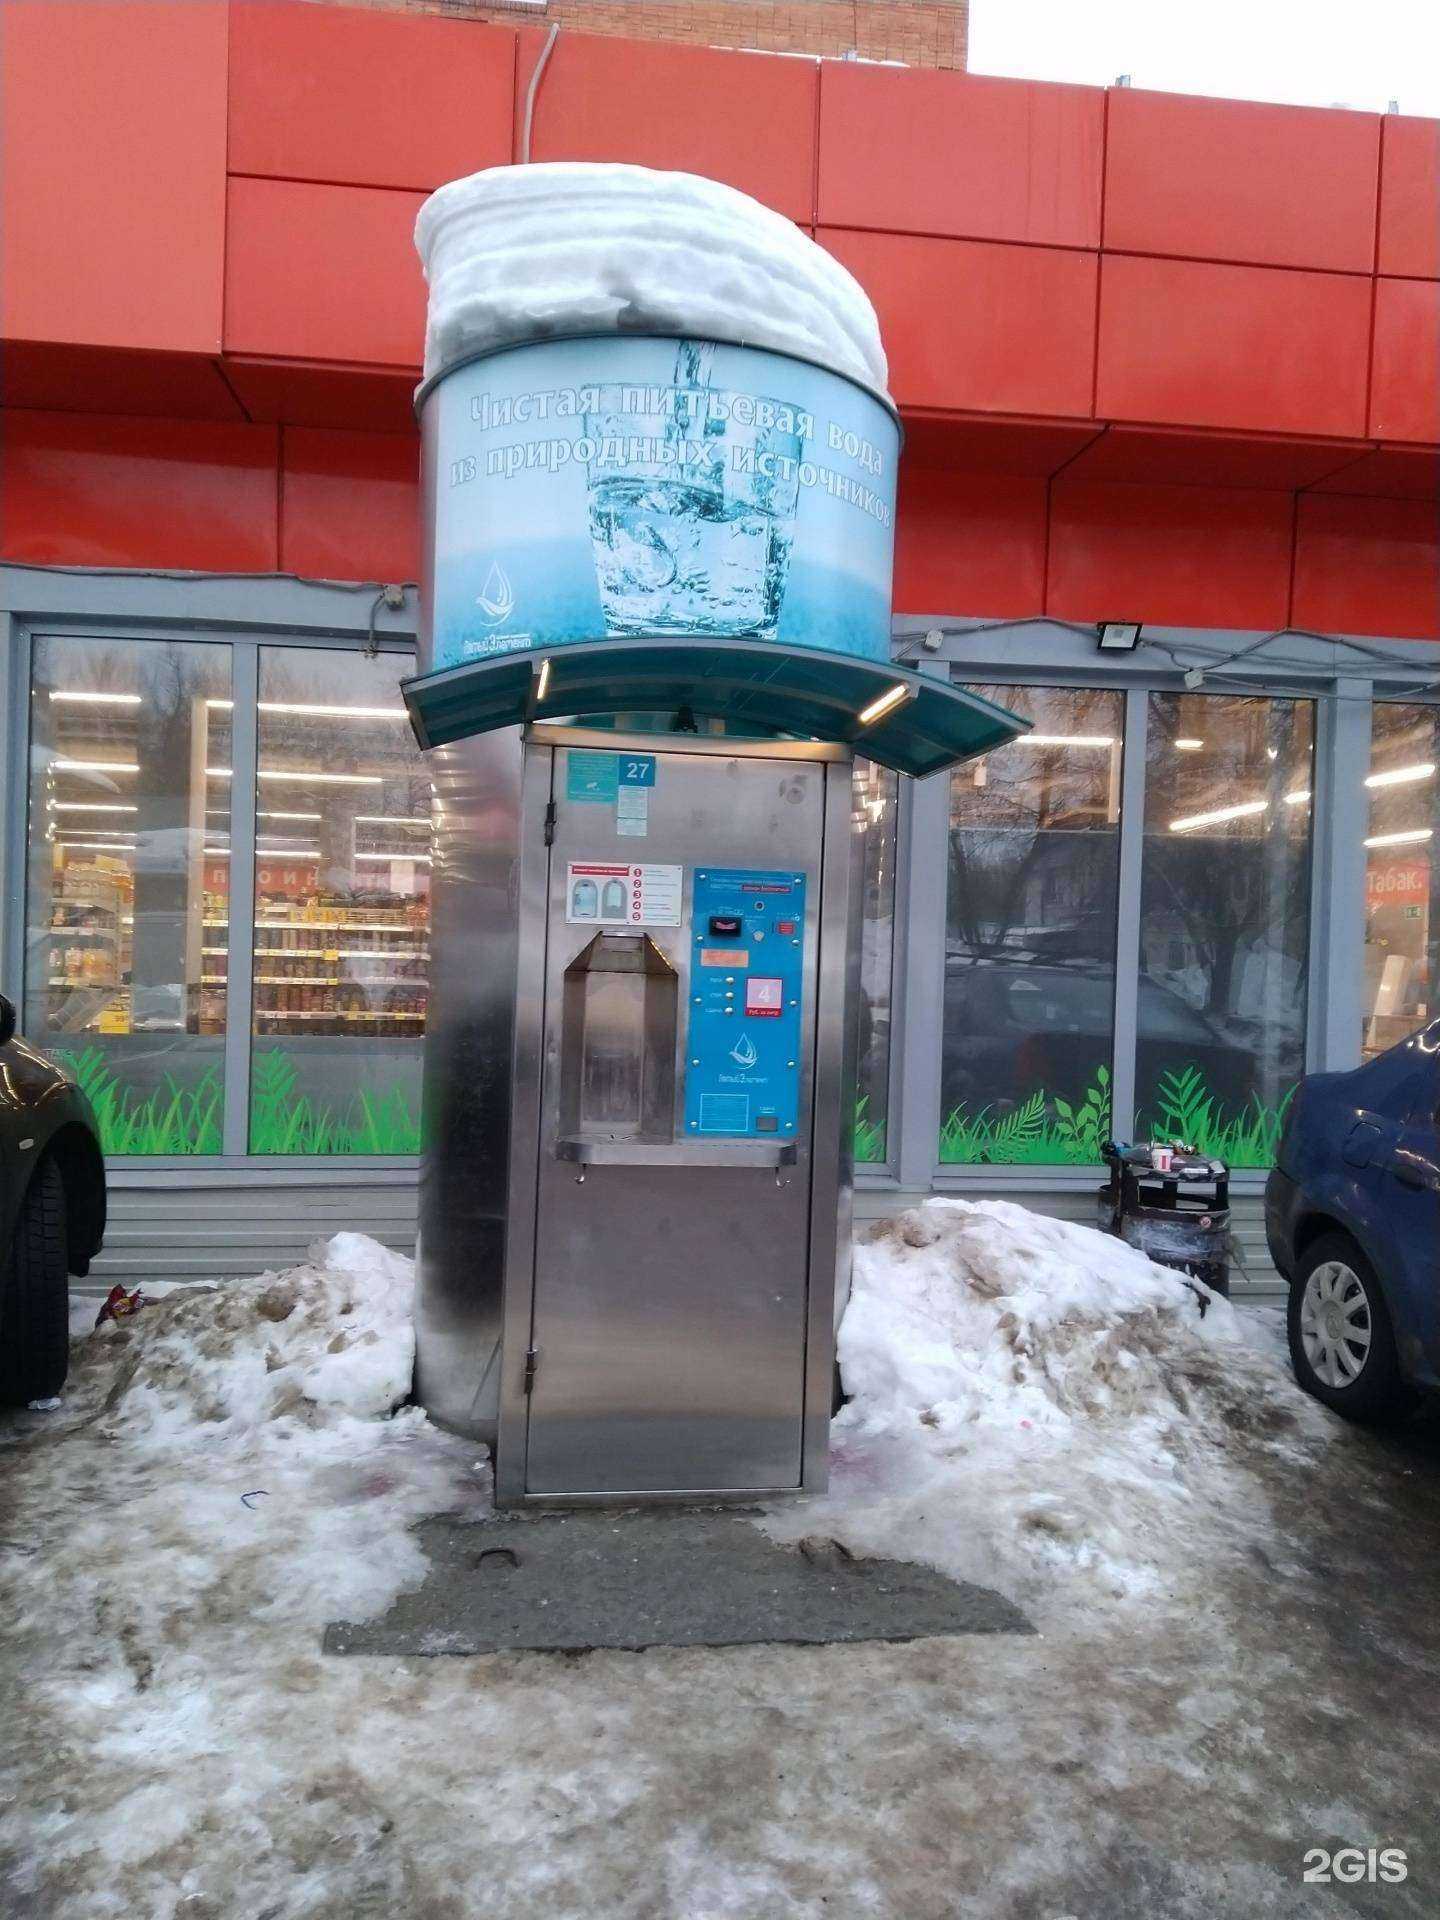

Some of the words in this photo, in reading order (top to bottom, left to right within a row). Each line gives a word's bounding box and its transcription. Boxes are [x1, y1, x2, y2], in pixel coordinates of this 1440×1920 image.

[470, 387, 602, 432] Чистая
[620, 386, 816, 441] питьевая
[827, 420, 884, 476] вода
[450, 455, 477, 488] из
[486, 435, 718, 480] природных
[731, 445, 890, 529] источников
[626, 762, 650, 779] 27
[758, 985, 770, 1003] 4
